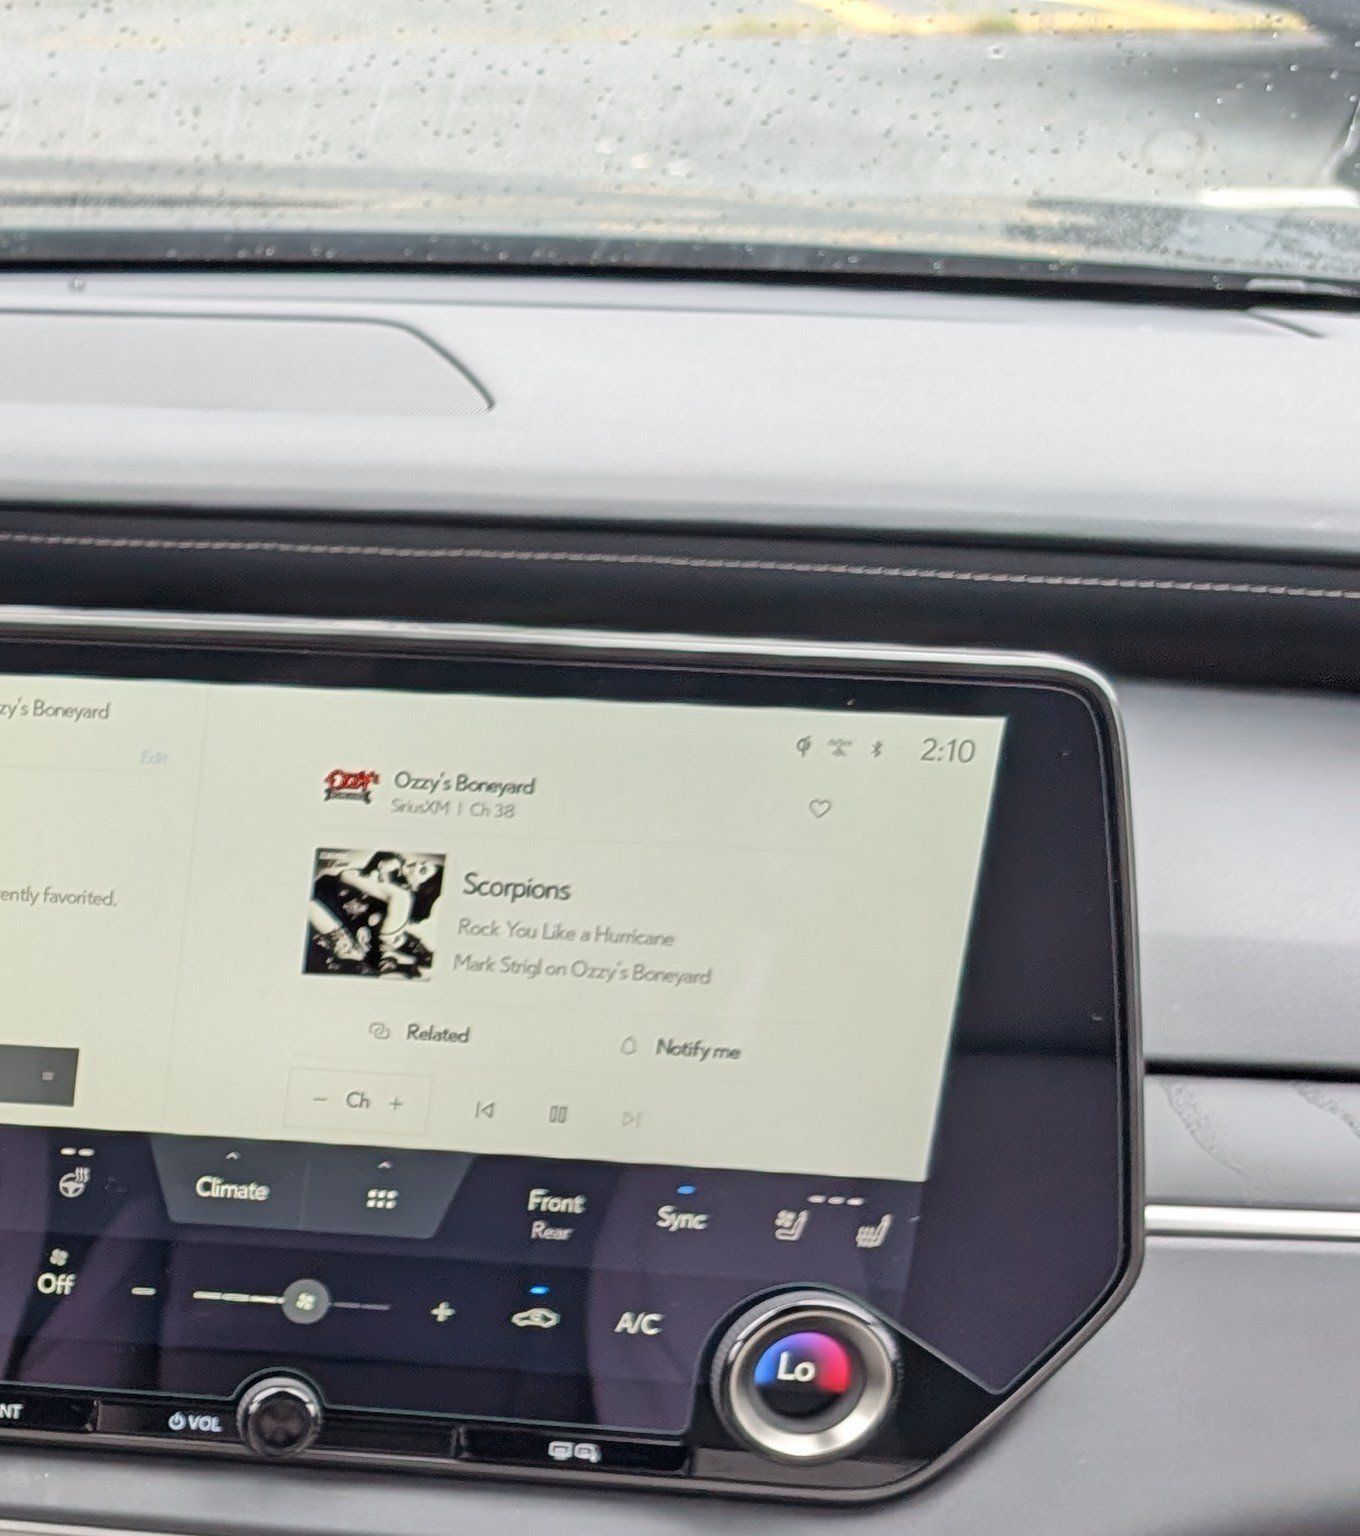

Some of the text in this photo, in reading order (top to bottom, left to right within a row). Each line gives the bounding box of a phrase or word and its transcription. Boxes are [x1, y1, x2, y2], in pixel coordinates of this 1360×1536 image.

[33, 699, 111, 721] Boneyard
[140, 750, 168, 765] Edit
[920, 737, 976, 764] 2:10
[394, 771, 537, 795] Ozzy's Boneyard
[390, 798, 516, 819] SiriusXM Ch 38
[43, 888, 118, 908] favorited.
[462, 872, 572, 904] Scorpions
[458, 919, 675, 948] Rock You Like a Hurricane
[453, 954, 713, 987] Mark Strigl on Ozzy's Boneyard
[406, 1024, 471, 1044] Related
[655, 1038, 742, 1062] Notify me
[346, 1091, 370, 1109] Ch
[195, 1175, 272, 1202] Climate
[527, 1188, 587, 1214] Front
[530, 1220, 574, 1241] Rear
[656, 1205, 709, 1232] Sync
[37, 1272, 77, 1295] Off
[615, 1311, 665, 1335] A/C
[776, 1352, 816, 1382] Lo
[188, 1416, 223, 1433] VOL
